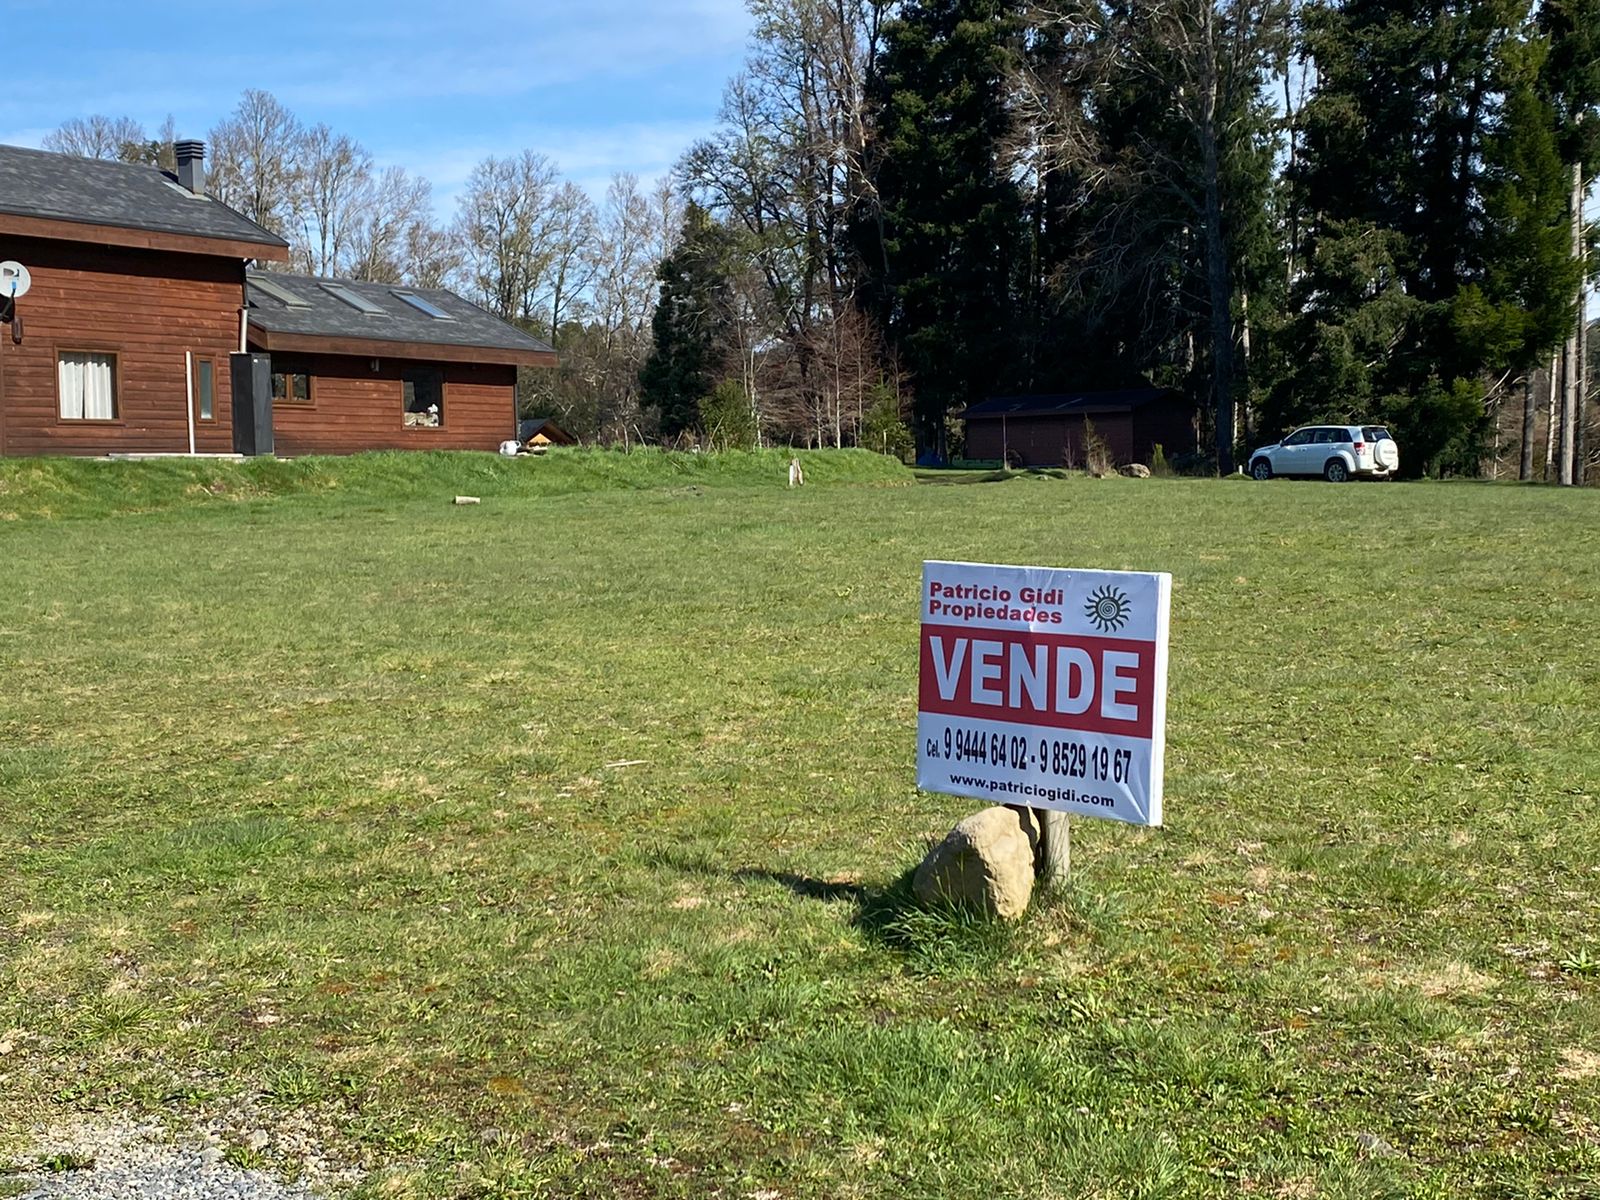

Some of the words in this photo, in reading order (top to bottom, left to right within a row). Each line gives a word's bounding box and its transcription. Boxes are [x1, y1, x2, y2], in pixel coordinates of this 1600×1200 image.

[930, 582, 1011, 601] Patricio
[1019, 587, 1064, 605] Gidi
[929, 600, 1062, 624] Propiedades
[929, 636, 1140, 721] VENDE
[926, 738, 940, 758] Cel.
[944, 727, 951, 760] 9
[955, 728, 986, 764] 9444
[990, 733, 1006, 767] 64
[1010, 736, 1027, 770] 02
[1040, 740, 1048, 773] 9
[1052, 742, 1086, 778] 8529
[1092, 745, 1109, 781] 19
[1113, 749, 1132, 784] 67
[949, 773, 1115, 808] www.patriciogidi.com
